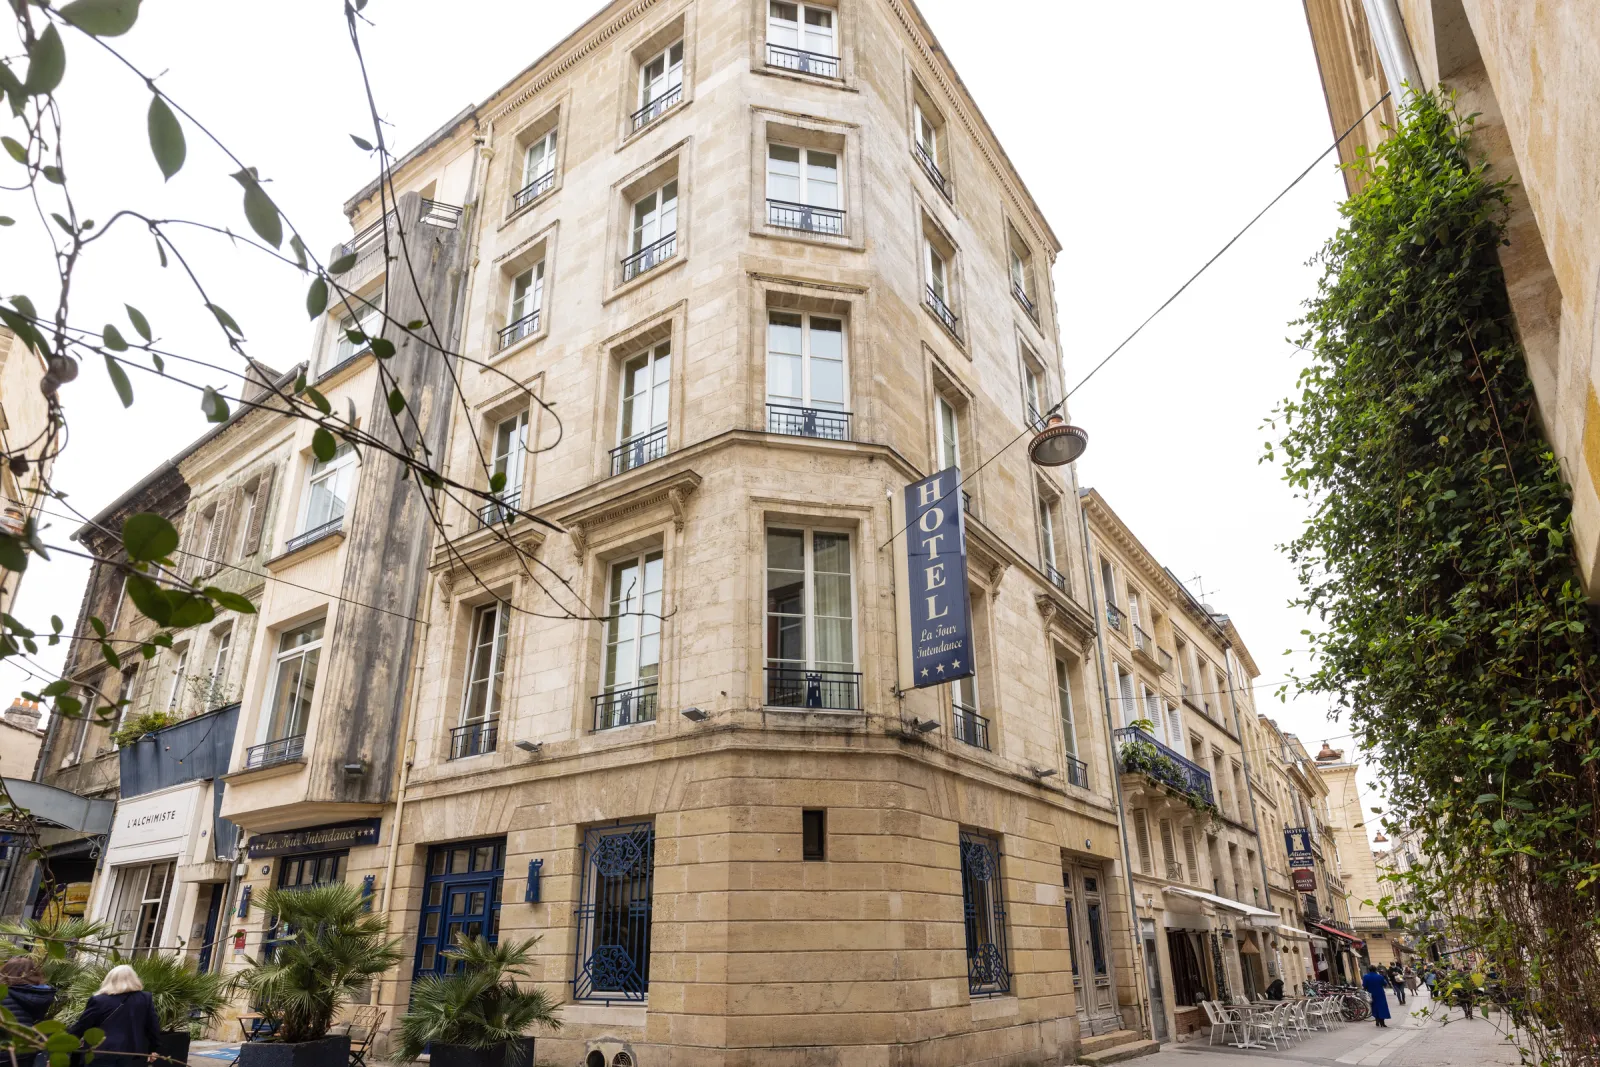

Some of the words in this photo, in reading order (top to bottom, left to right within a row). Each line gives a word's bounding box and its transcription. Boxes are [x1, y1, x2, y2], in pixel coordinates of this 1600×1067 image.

[917, 476, 948, 621] HOTEL
[920, 627, 933, 643] La
[935, 624, 957, 639] Tour
[916, 639, 963, 659] Intendance
[127, 810, 176, 828] L'ALCHIMISTE
[265, 836, 277, 850] La
[280, 835, 301, 849] Tour
[302, 828, 356, 846] Intendance
